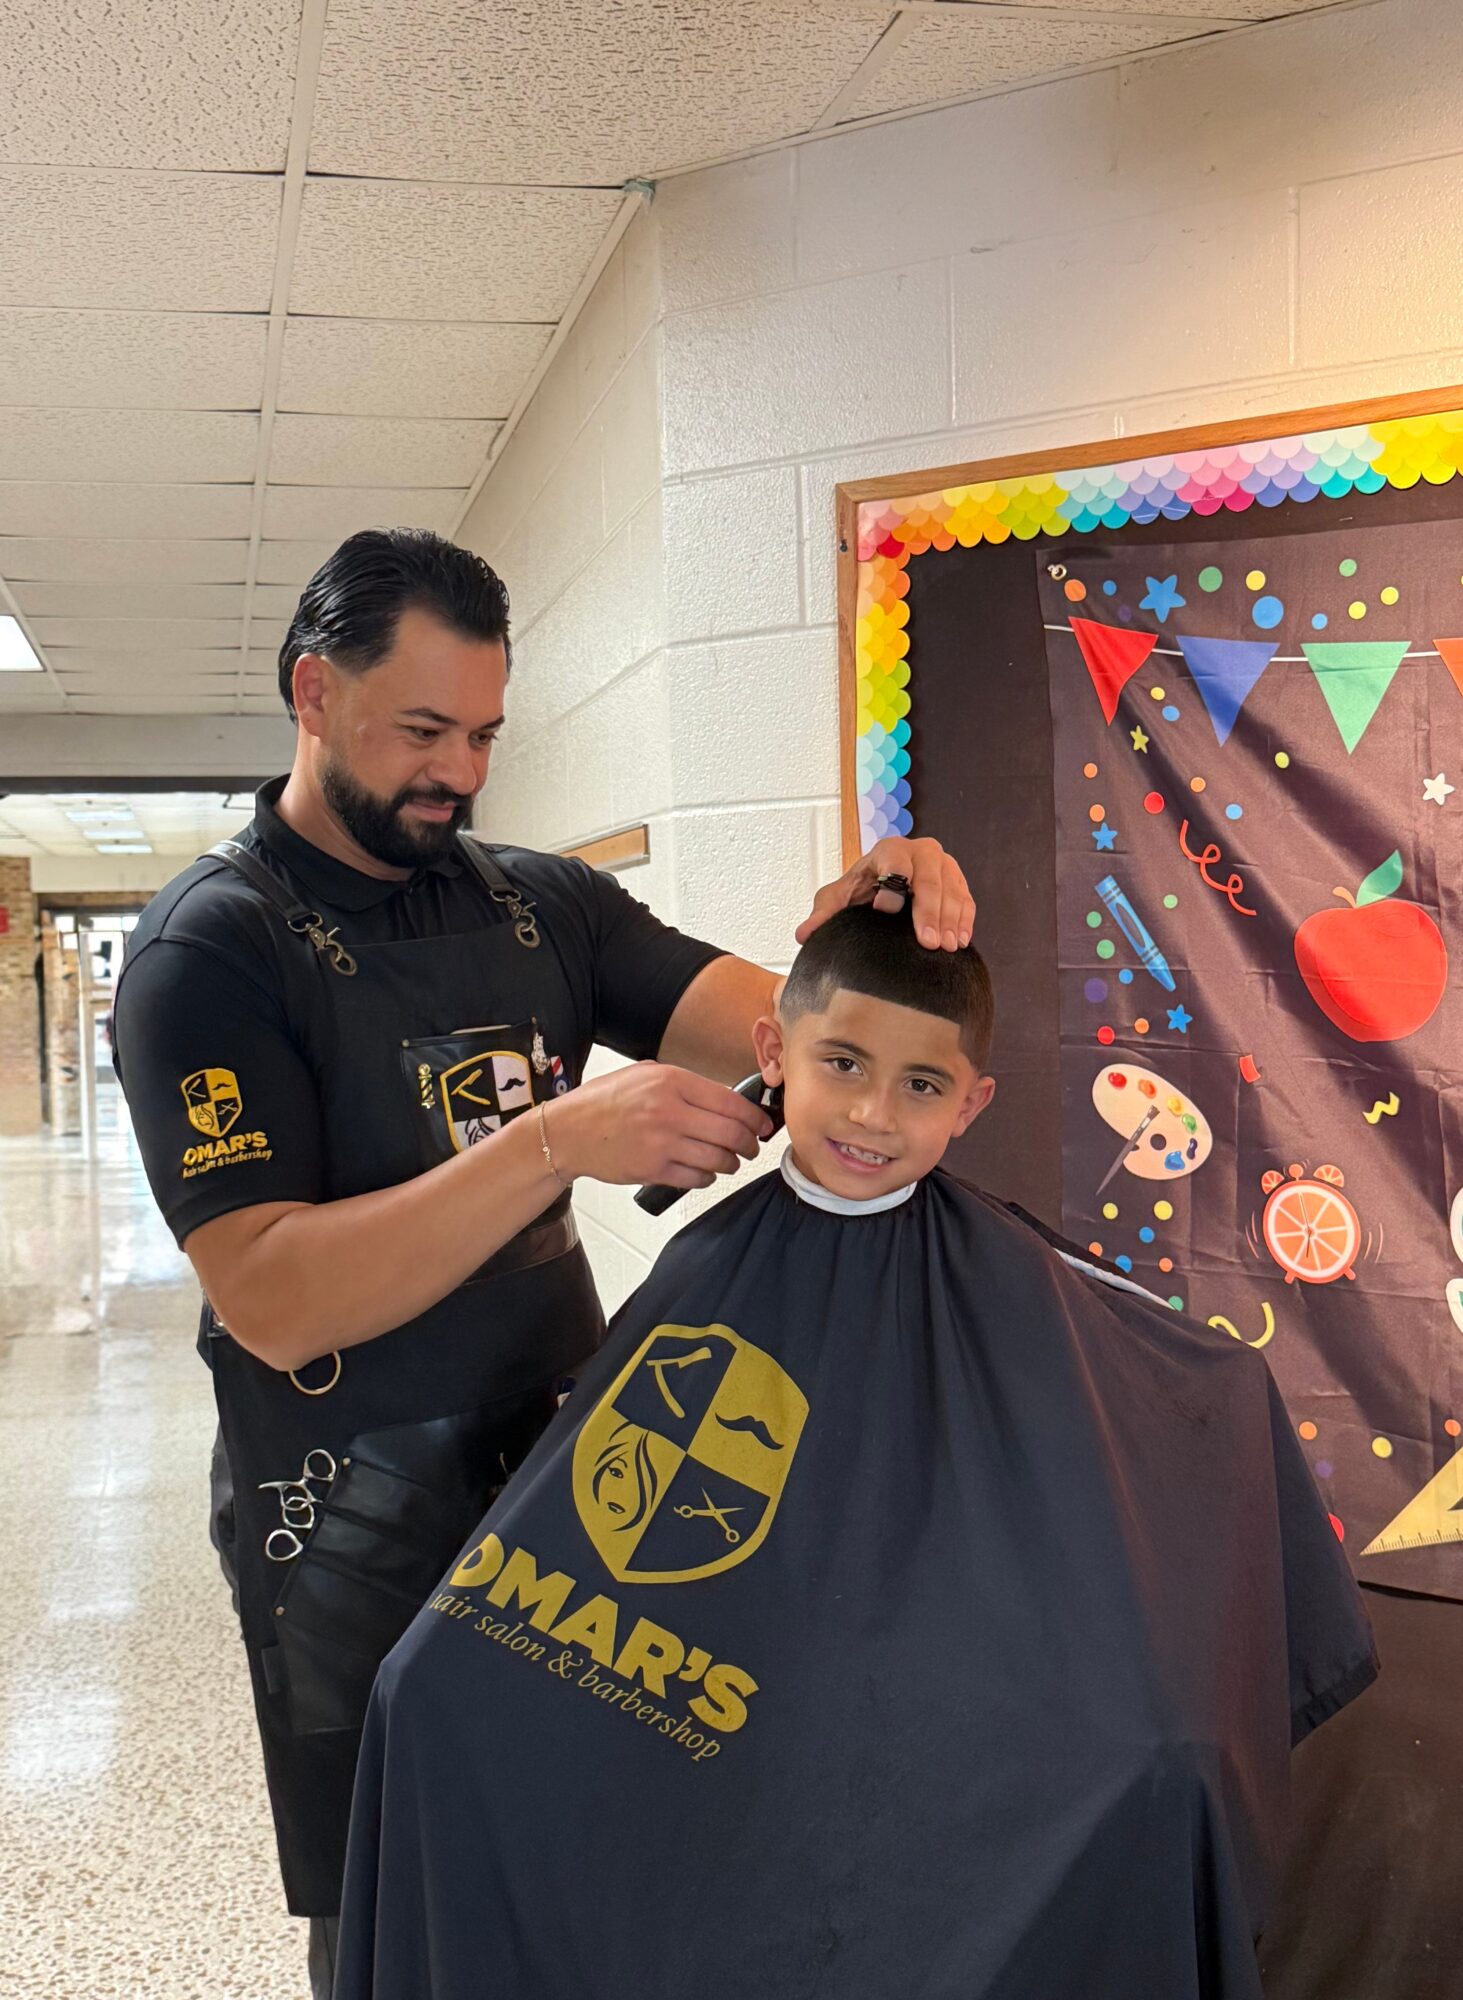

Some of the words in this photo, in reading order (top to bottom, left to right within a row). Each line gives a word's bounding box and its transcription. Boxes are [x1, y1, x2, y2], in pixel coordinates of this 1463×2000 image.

[183, 1131, 268, 1166] OMAR'S
[217, 1157, 224, 1167] &
[474, 1615, 546, 1661] salon
[547, 1649, 584, 1679] &
[578, 1664, 721, 1762] barbershop
